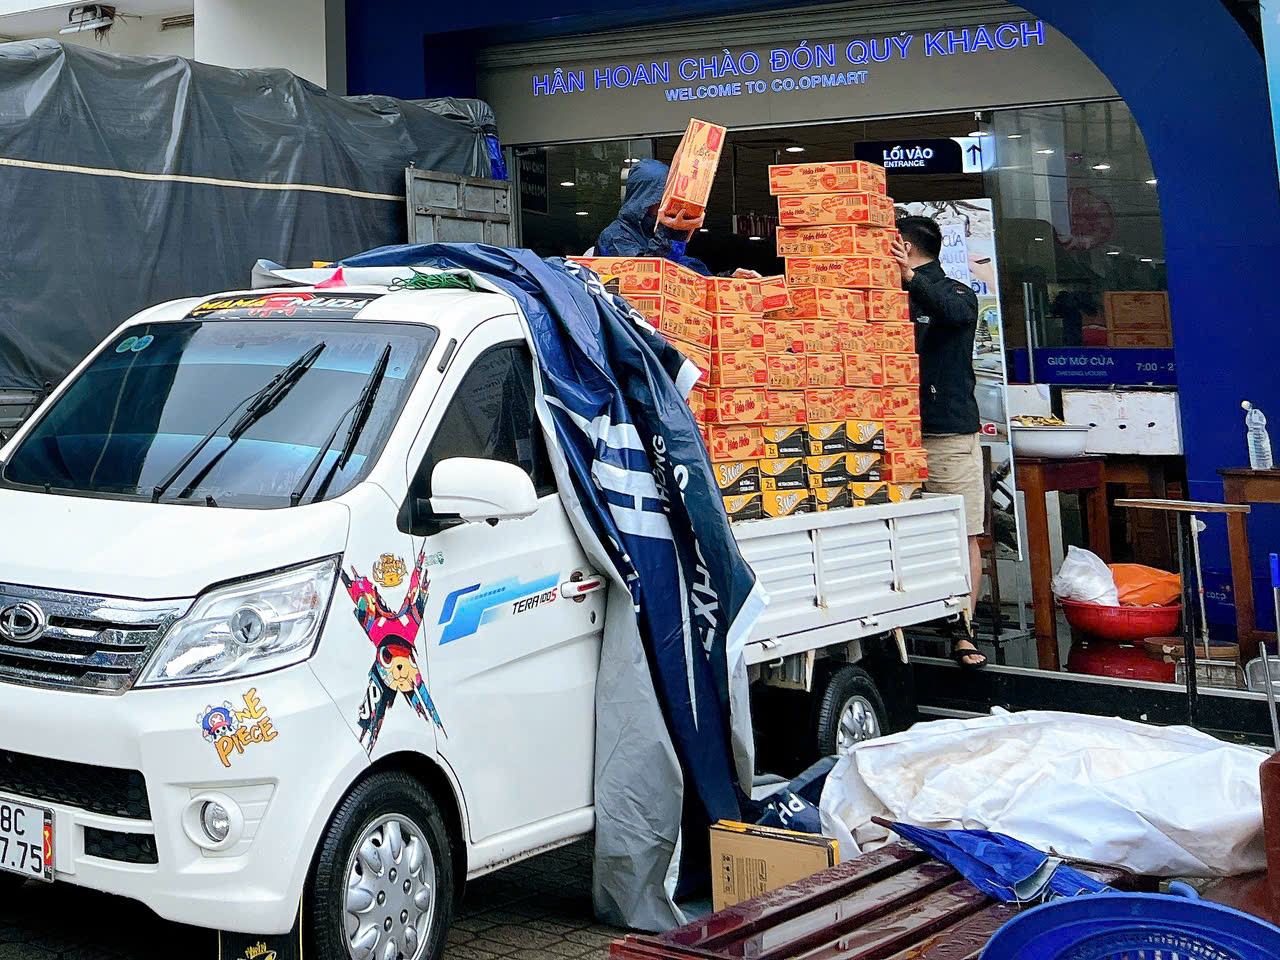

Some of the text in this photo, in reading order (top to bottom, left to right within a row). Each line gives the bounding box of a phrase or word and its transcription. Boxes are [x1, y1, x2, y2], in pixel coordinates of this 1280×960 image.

[532, 68, 585, 96] HÂN
[593, 61, 670, 90] HOAN
[678, 48, 761, 80] CHÀO
[769, 40, 836, 72] ĐÓN
[665, 70, 869, 101] WELCOME TO CO.OPMART
[906, 145, 934, 159] VÀO
[883, 159, 926, 168] ENTRANCE
[1136, 362, 1158, 372] 7:00
[512, 595, 540, 616] TERA
[214, 716, 279, 768] PIECE
